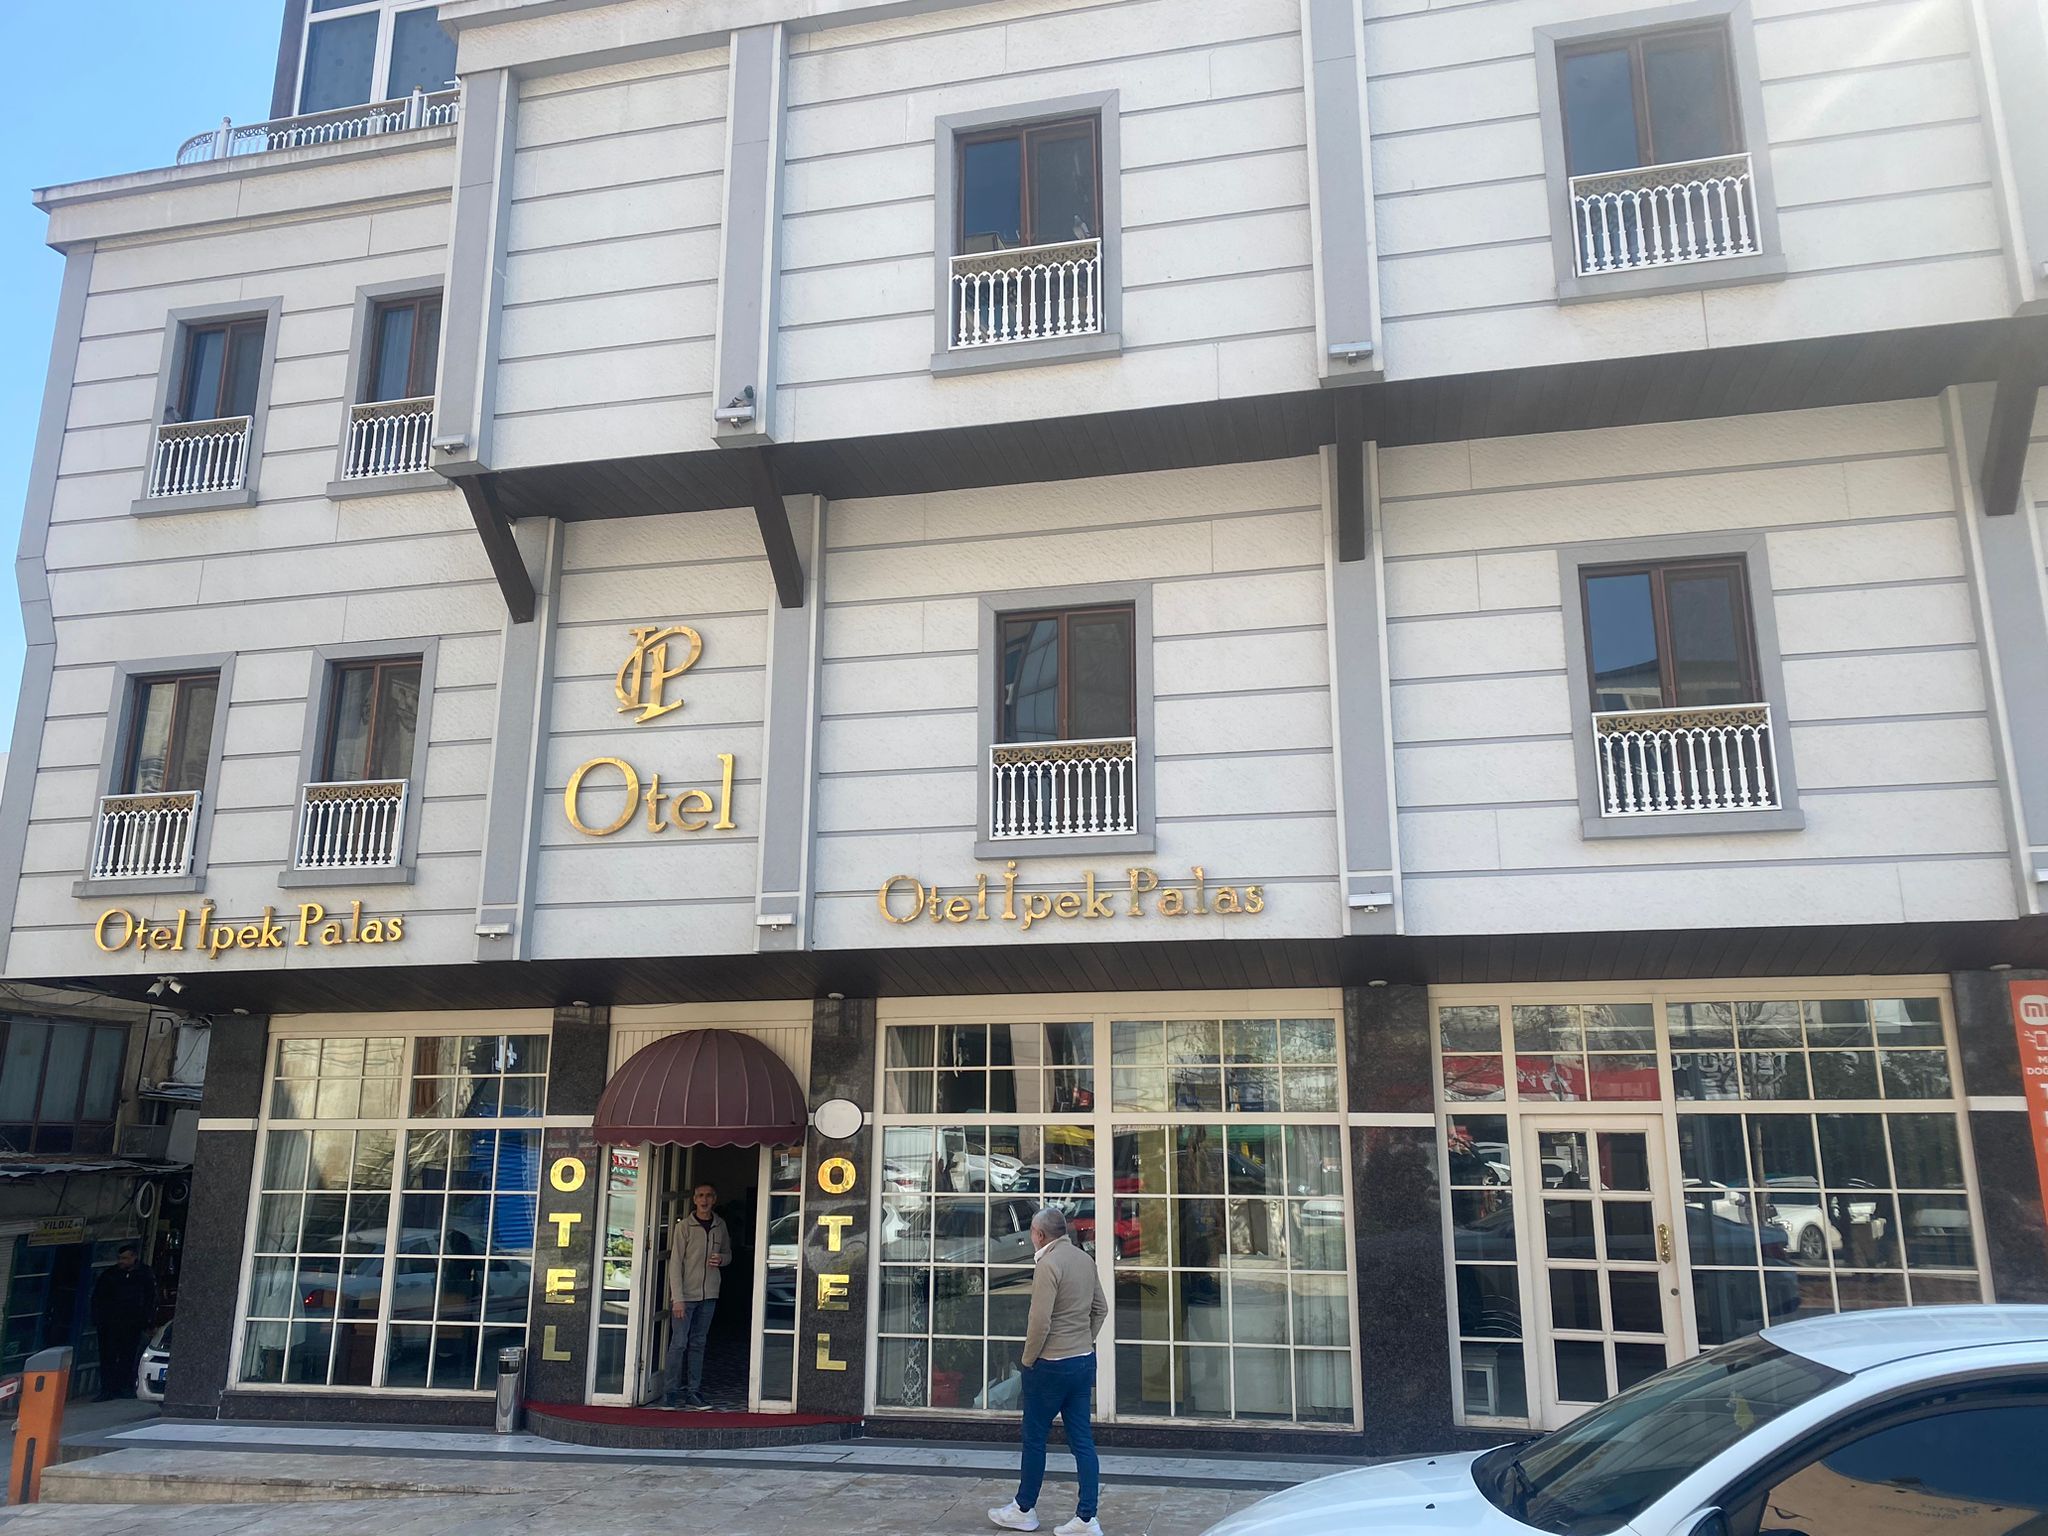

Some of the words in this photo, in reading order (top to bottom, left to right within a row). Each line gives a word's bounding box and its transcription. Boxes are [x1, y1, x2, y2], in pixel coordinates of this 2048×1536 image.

[564, 753, 737, 836] Otel
[94, 907, 188, 952] Otel
[294, 900, 405, 947] Palas
[877, 872, 990, 924] Otel
[1001, 859, 1115, 930] İpek
[1128, 865, 1264, 918] Palas
[542, 1157, 586, 1361] OTEL
[817, 1157, 857, 1371] OTEL
